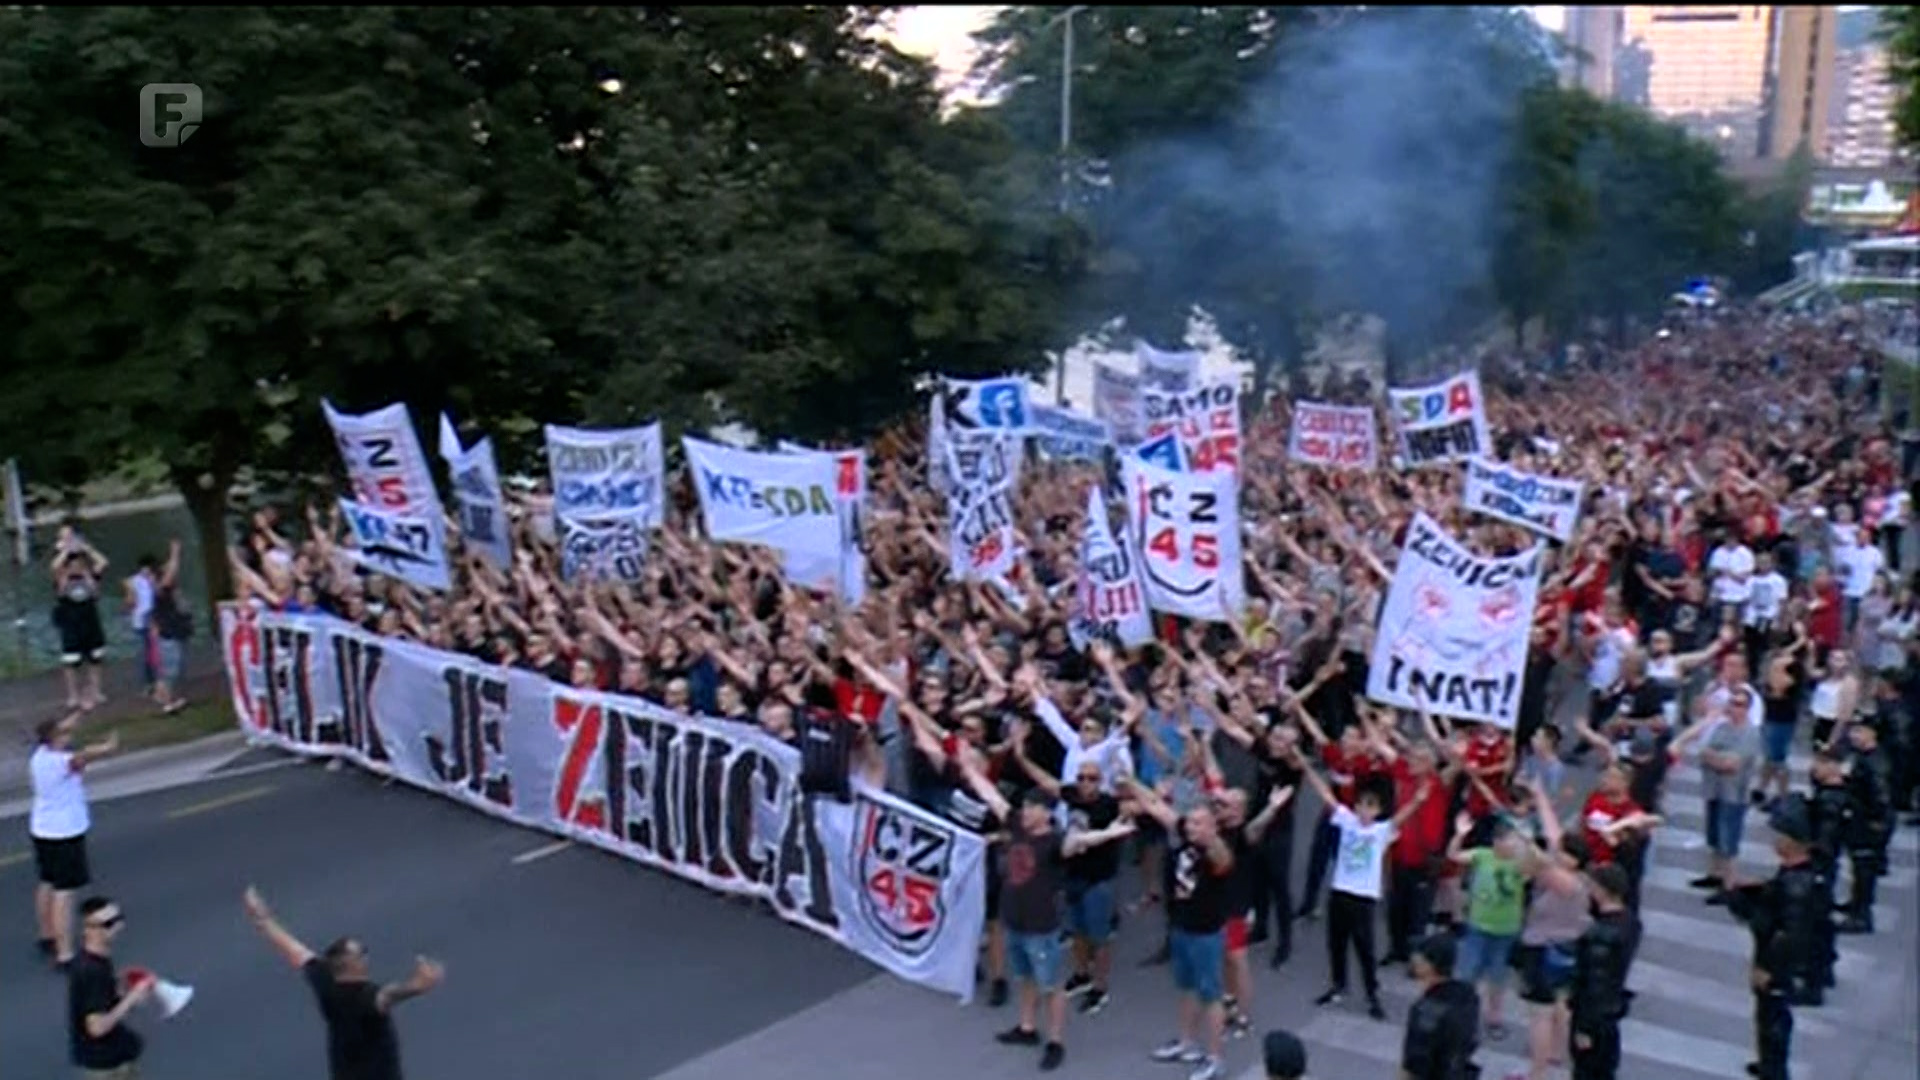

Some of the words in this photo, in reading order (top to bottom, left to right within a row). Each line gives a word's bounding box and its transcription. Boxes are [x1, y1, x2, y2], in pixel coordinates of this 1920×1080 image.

[1400, 382, 1473, 427] SDA
[1149, 527, 1219, 568] 45
[426, 667, 514, 807] JE
[553, 697, 840, 930] ZENICA
[870, 868, 938, 923] 45
